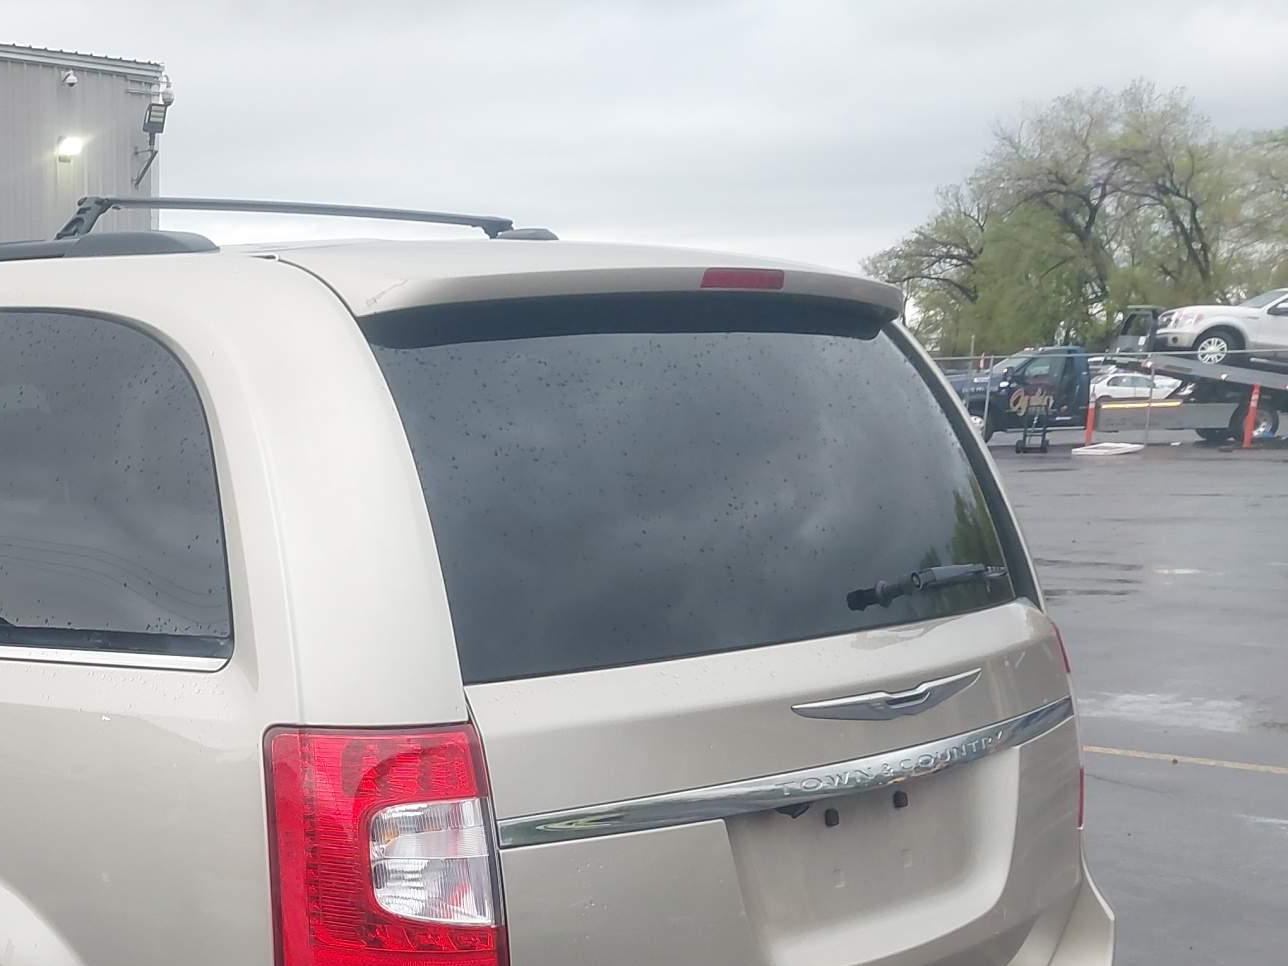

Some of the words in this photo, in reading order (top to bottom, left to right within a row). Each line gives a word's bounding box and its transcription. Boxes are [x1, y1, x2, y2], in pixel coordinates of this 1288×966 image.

[775, 766, 873, 796] TOWN
[882, 761, 895, 778] &
[899, 730, 1004, 770] COUNTRY
